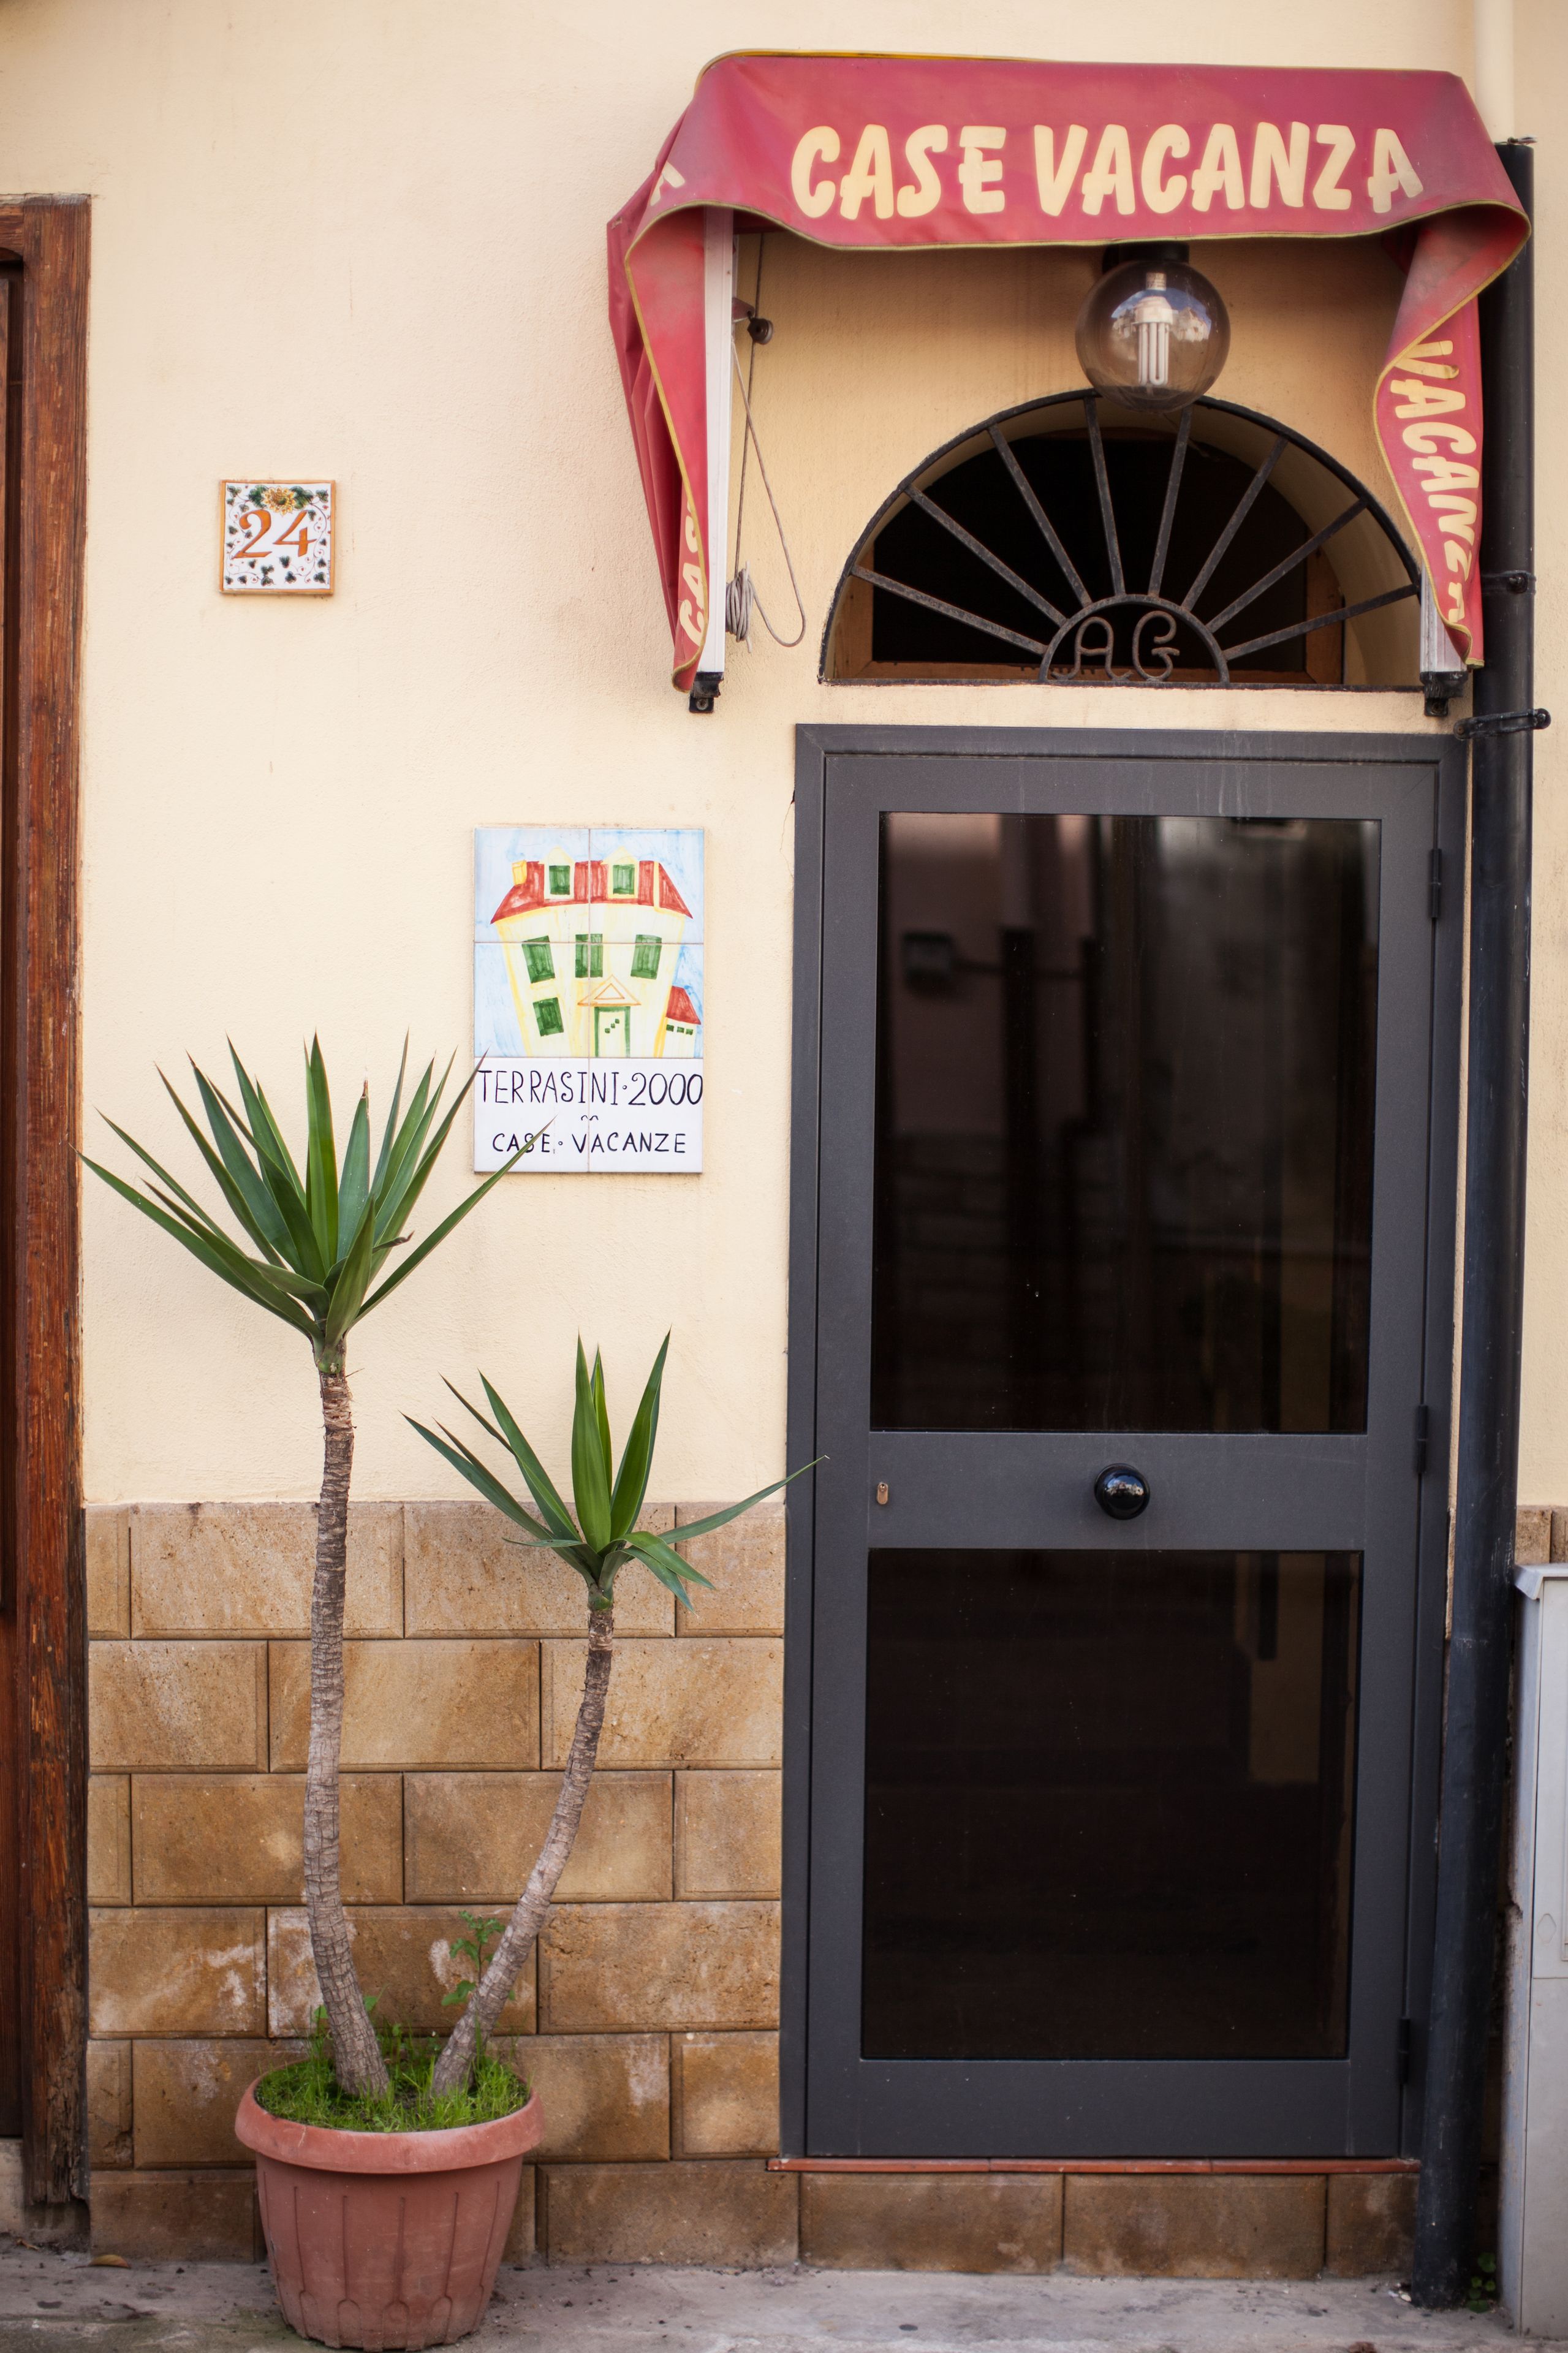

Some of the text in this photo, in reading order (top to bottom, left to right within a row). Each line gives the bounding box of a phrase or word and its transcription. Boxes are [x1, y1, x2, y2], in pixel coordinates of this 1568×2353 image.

[791, 124, 1007, 220] CASE
[1034, 121, 1424, 216] VACANZA
[233, 509, 317, 558] 24
[492, 1132, 686, 1153] CASE VACANZE
